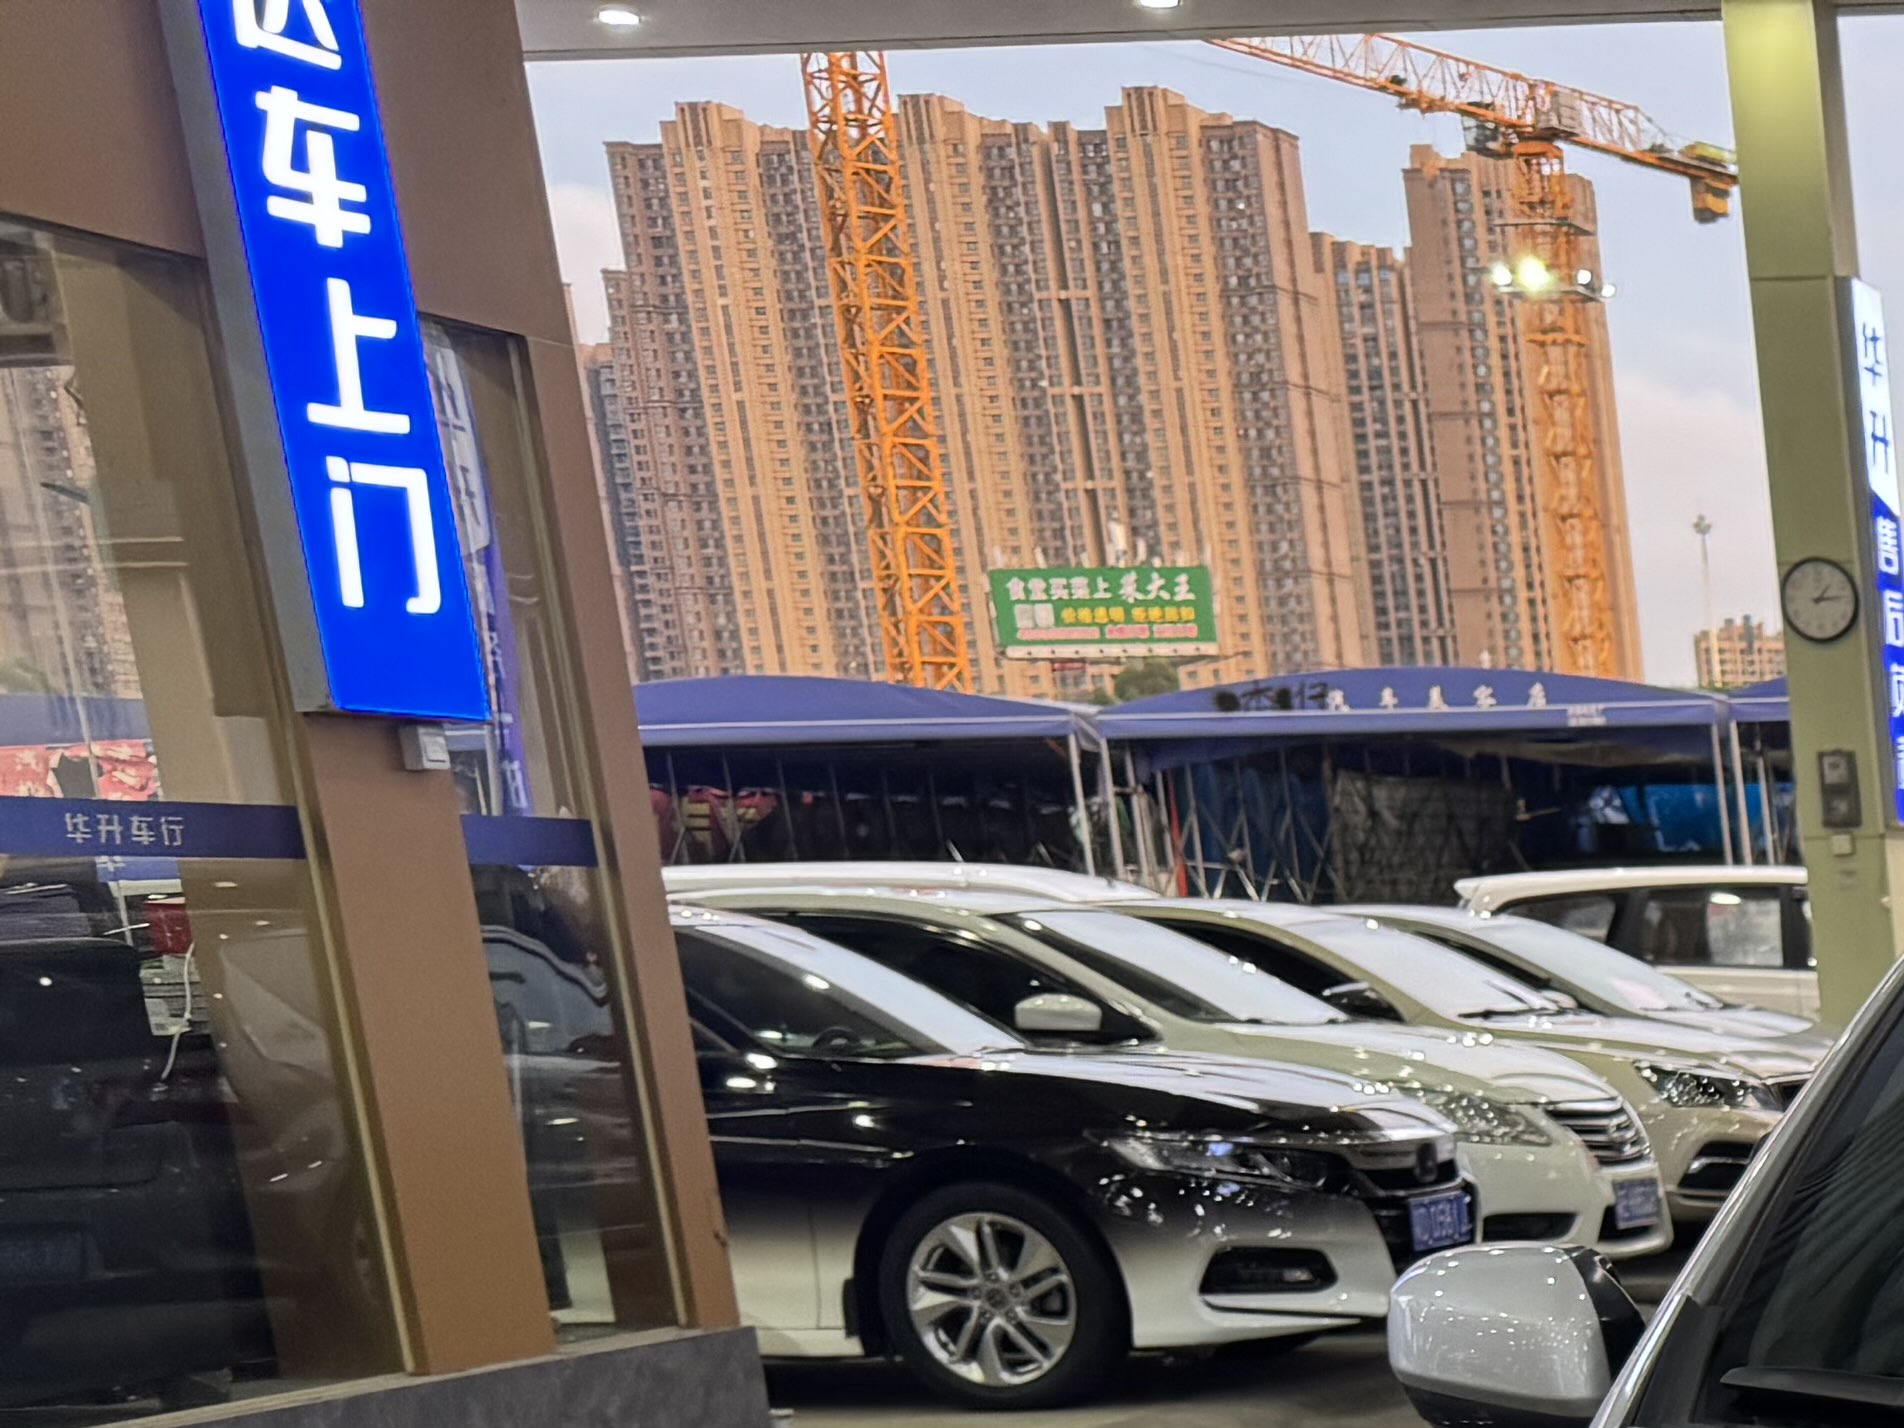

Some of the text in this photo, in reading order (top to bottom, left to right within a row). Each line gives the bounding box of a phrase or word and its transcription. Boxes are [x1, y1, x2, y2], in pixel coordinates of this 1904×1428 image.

[1863, 322, 1890, 476] 华升
[65, 813, 184, 846] 华升车行
